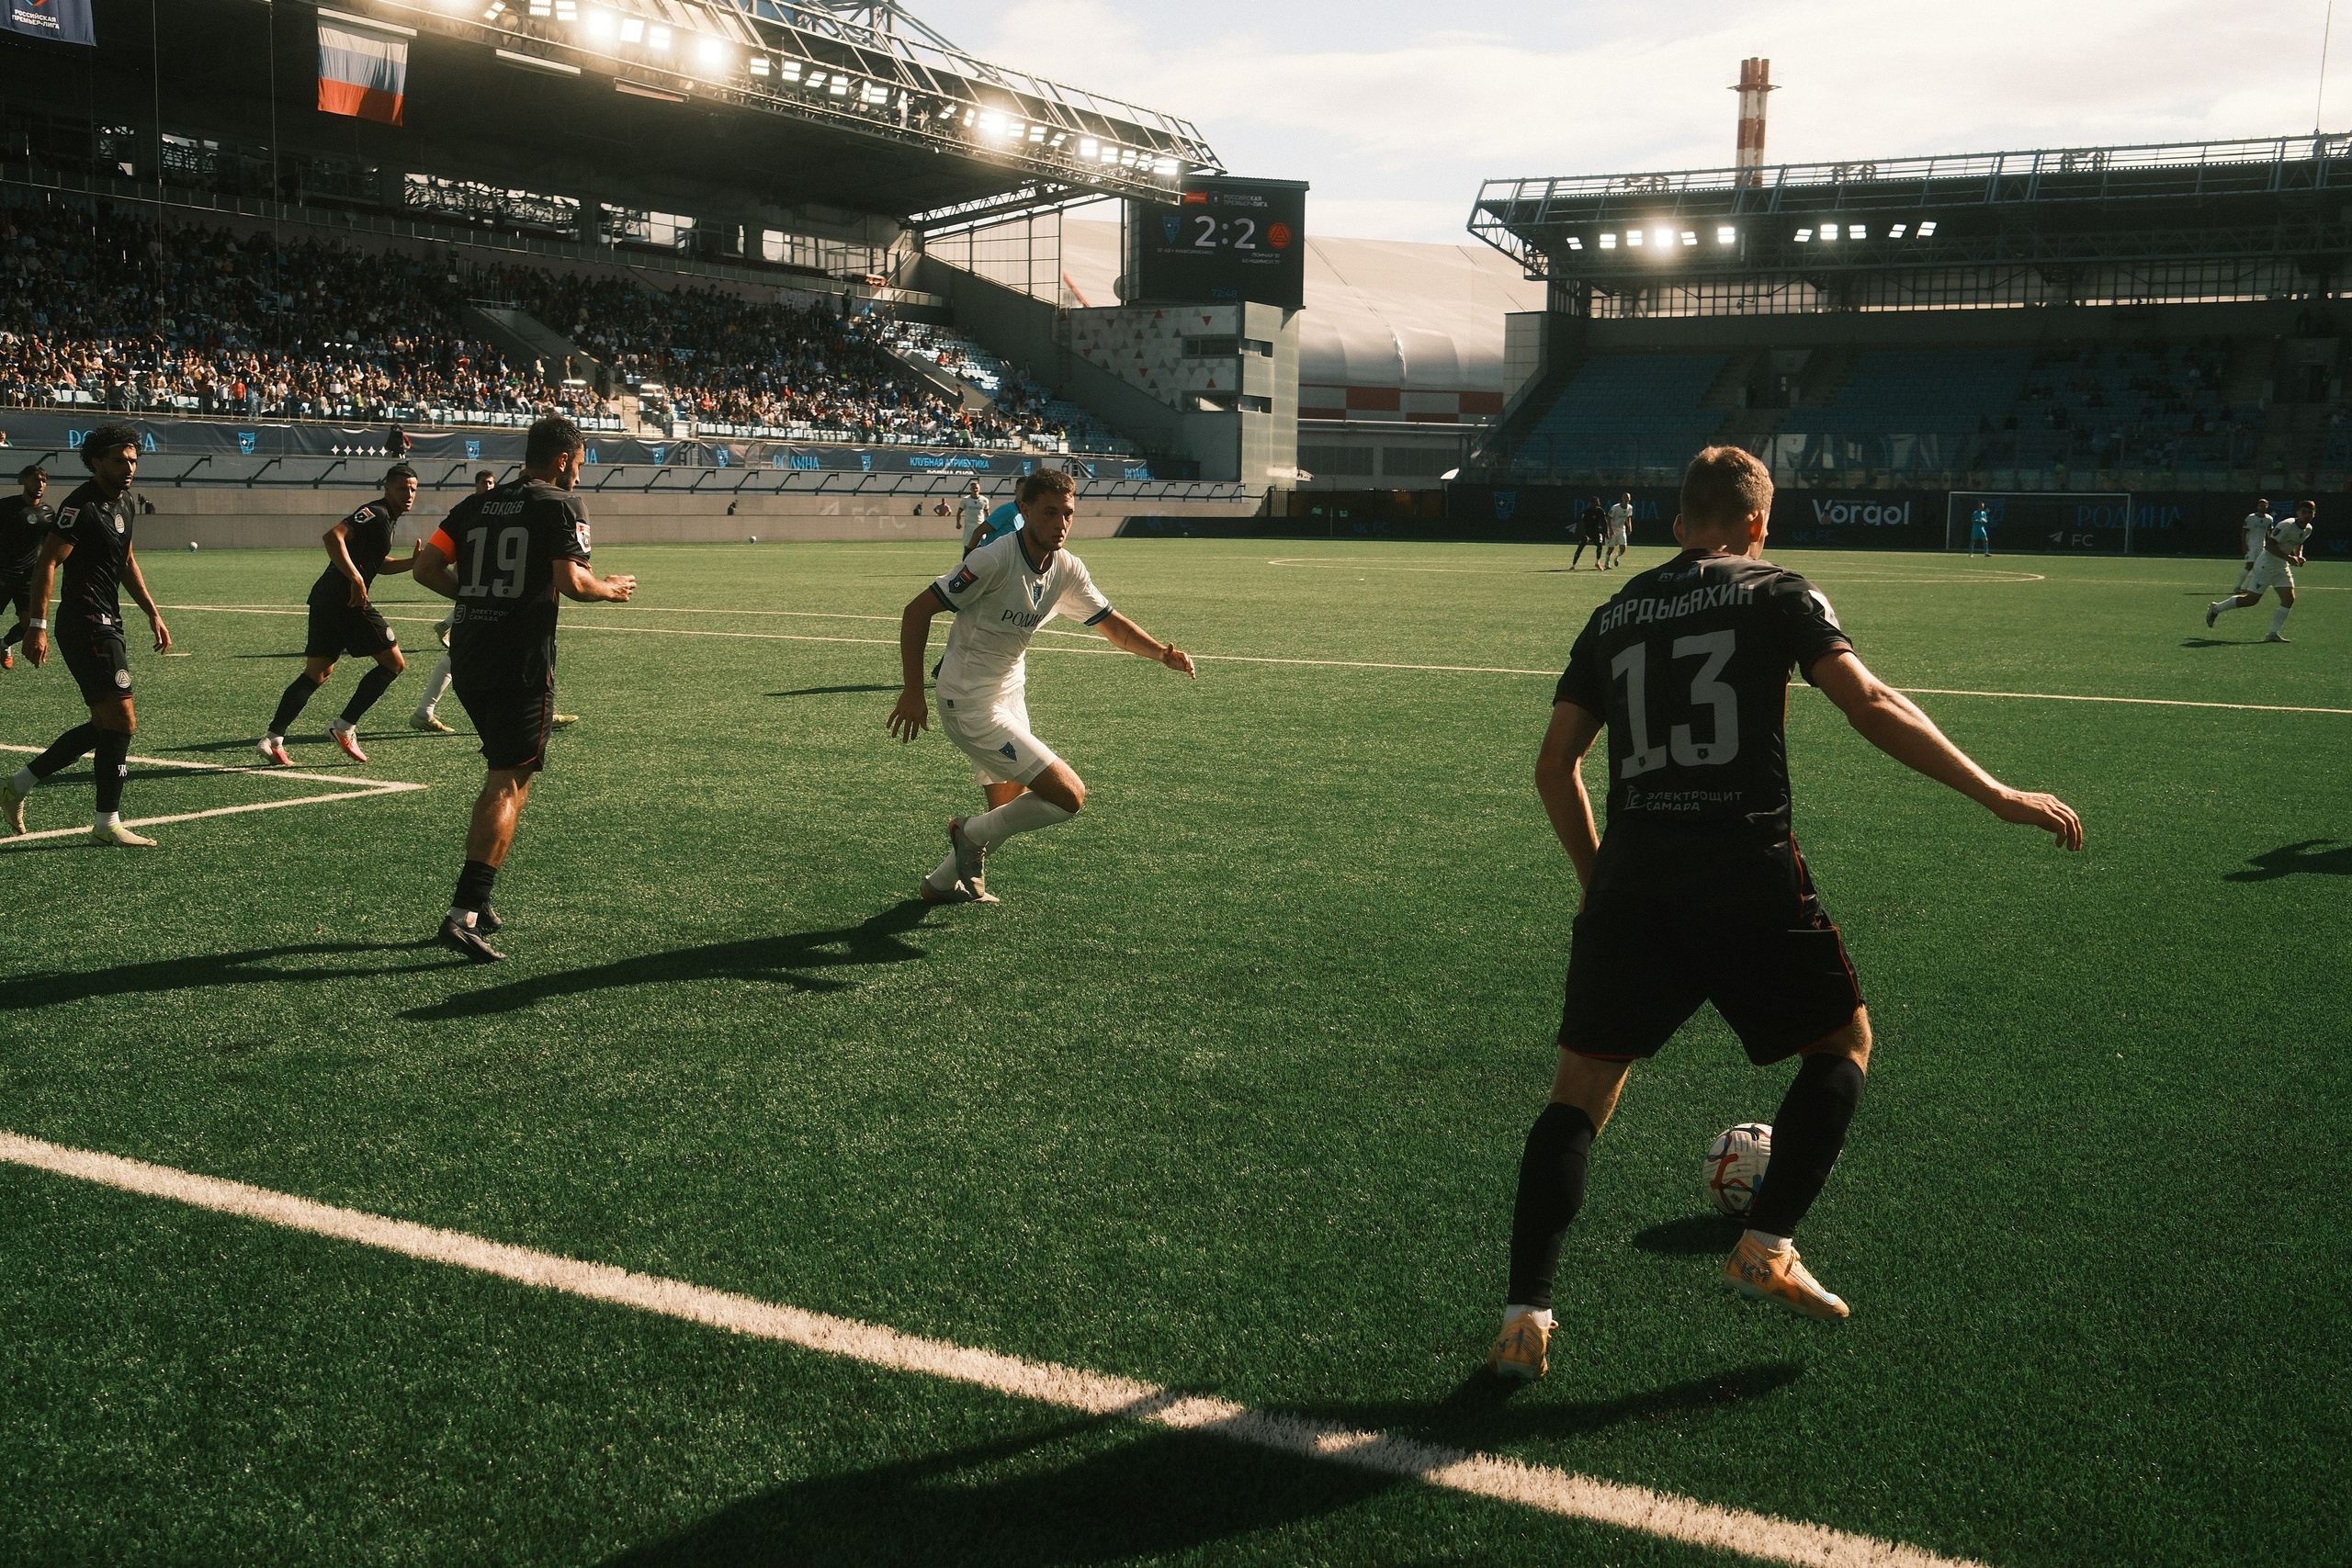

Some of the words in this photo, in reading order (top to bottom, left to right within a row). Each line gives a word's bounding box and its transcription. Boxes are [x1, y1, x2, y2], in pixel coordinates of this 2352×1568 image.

[11, 14, 60, 29] ПРЕМЬЕР-ЛИГА
[14, 8, 57, 23] РОССИЙСКАЯ
[1194, 215, 1256, 249] 2:2
[910, 457, 944, 467] КЛУБНАЯ
[944, 457, 989, 468] АТРИБУТИКА
[481, 501, 525, 515] БОКОЕВ
[2072, 534, 2095, 547] FC
[458, 526, 529, 599] 19
[1599, 584, 1754, 636] БАРДЫБАХИН
[1611, 629, 1739, 779] 13
[1645, 791, 1743, 803] ЭЛЕКТРОЩИТ
[1646, 801, 1701, 812] САМАРА
